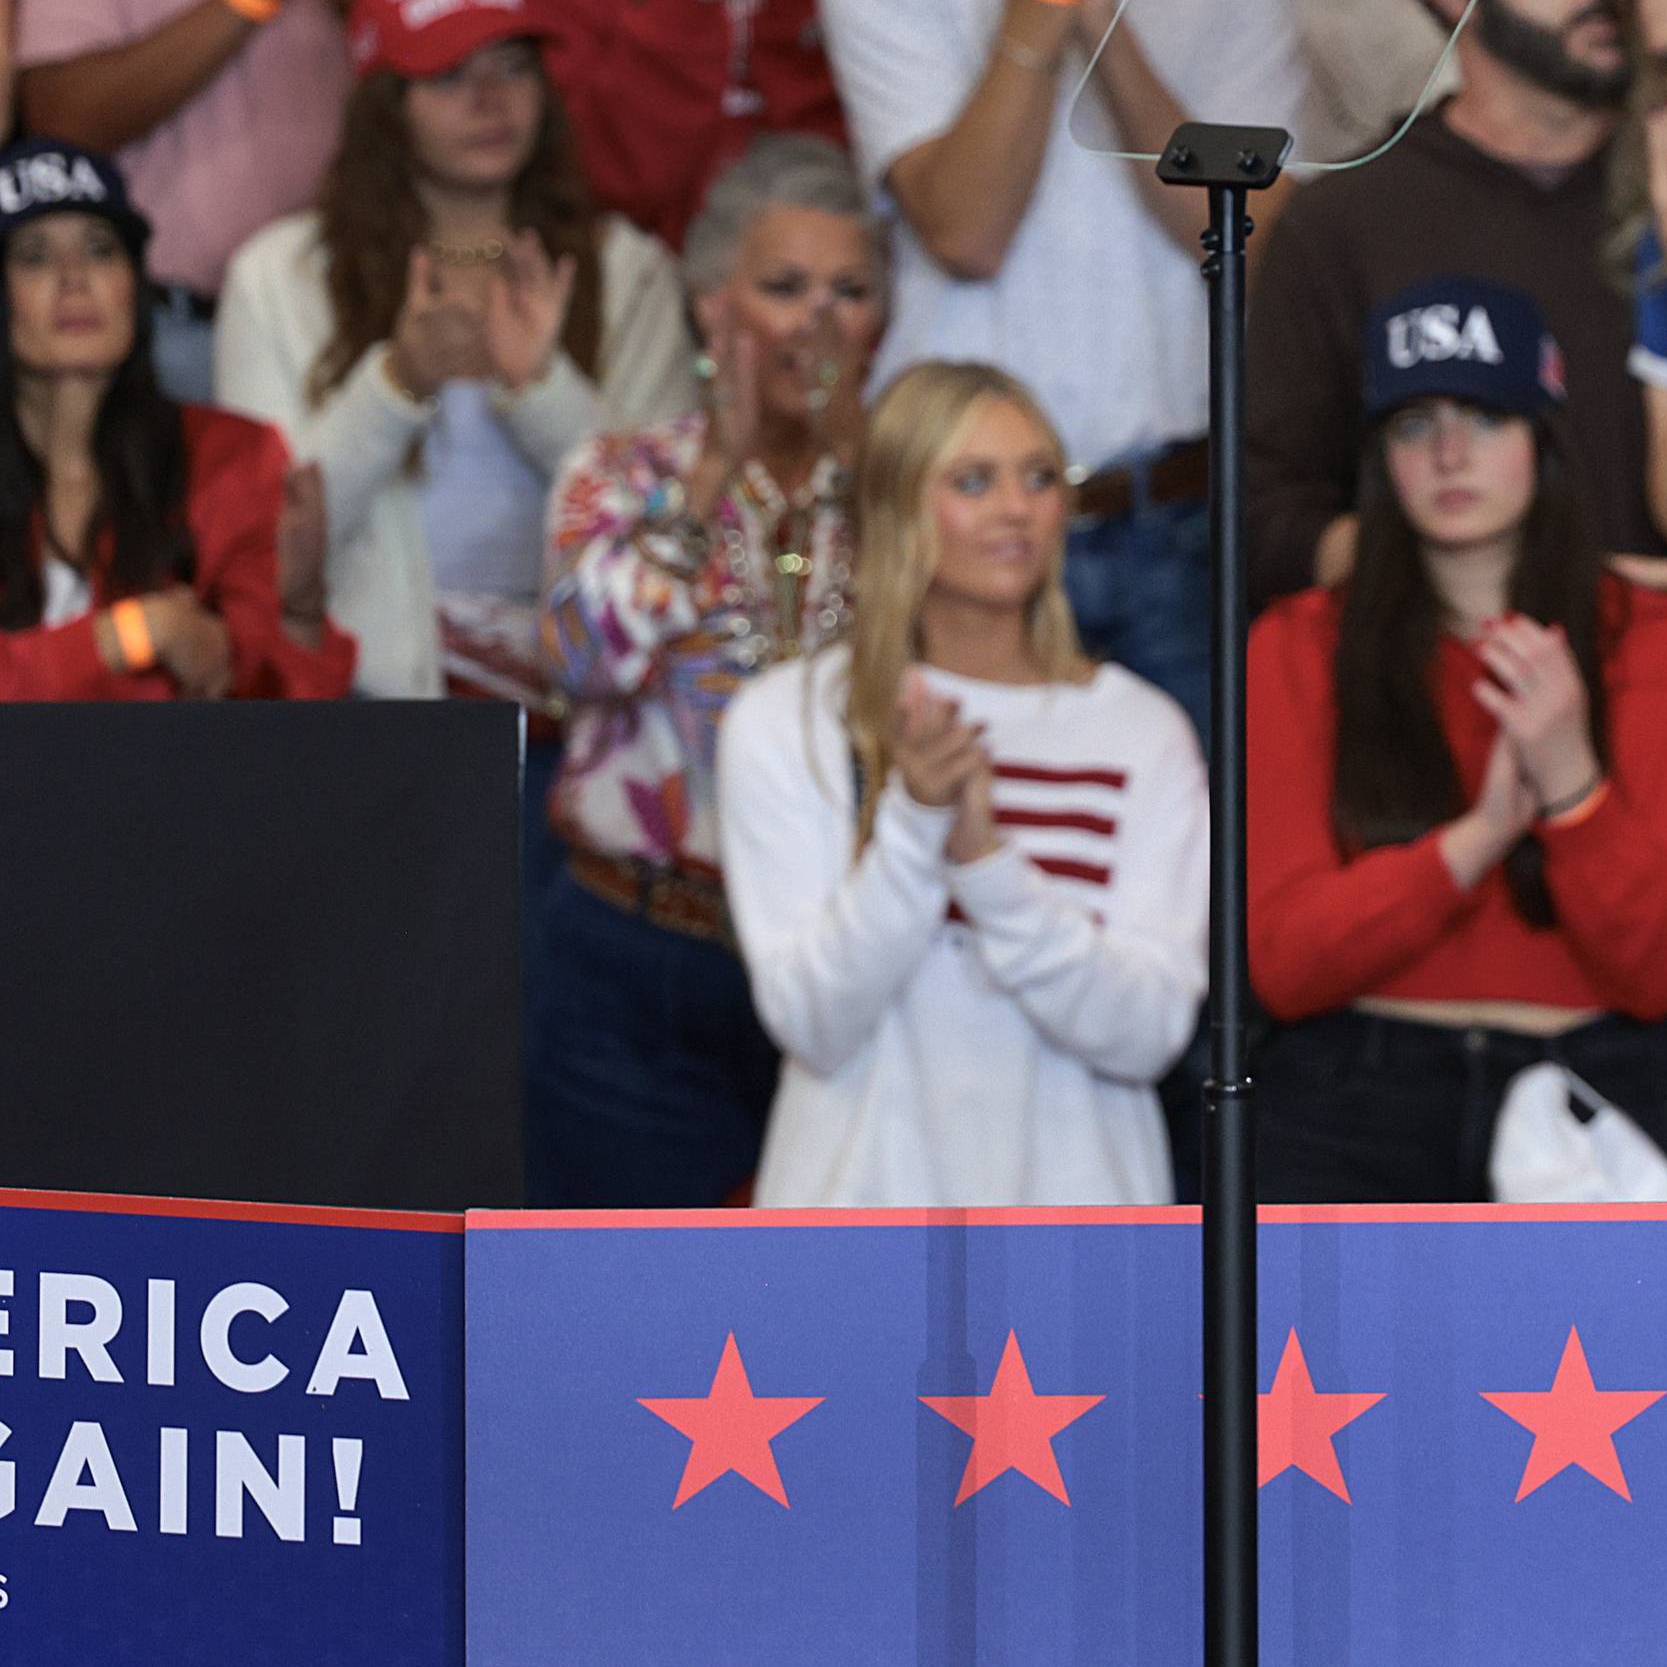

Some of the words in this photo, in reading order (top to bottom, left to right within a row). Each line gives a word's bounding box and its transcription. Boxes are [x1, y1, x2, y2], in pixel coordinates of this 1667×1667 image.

[0, 153, 107, 214] USA
[1386, 304, 1504, 369] USA
[0, 1269, 411, 1400] RICA
[0, 1421, 364, 1545] AIN!
